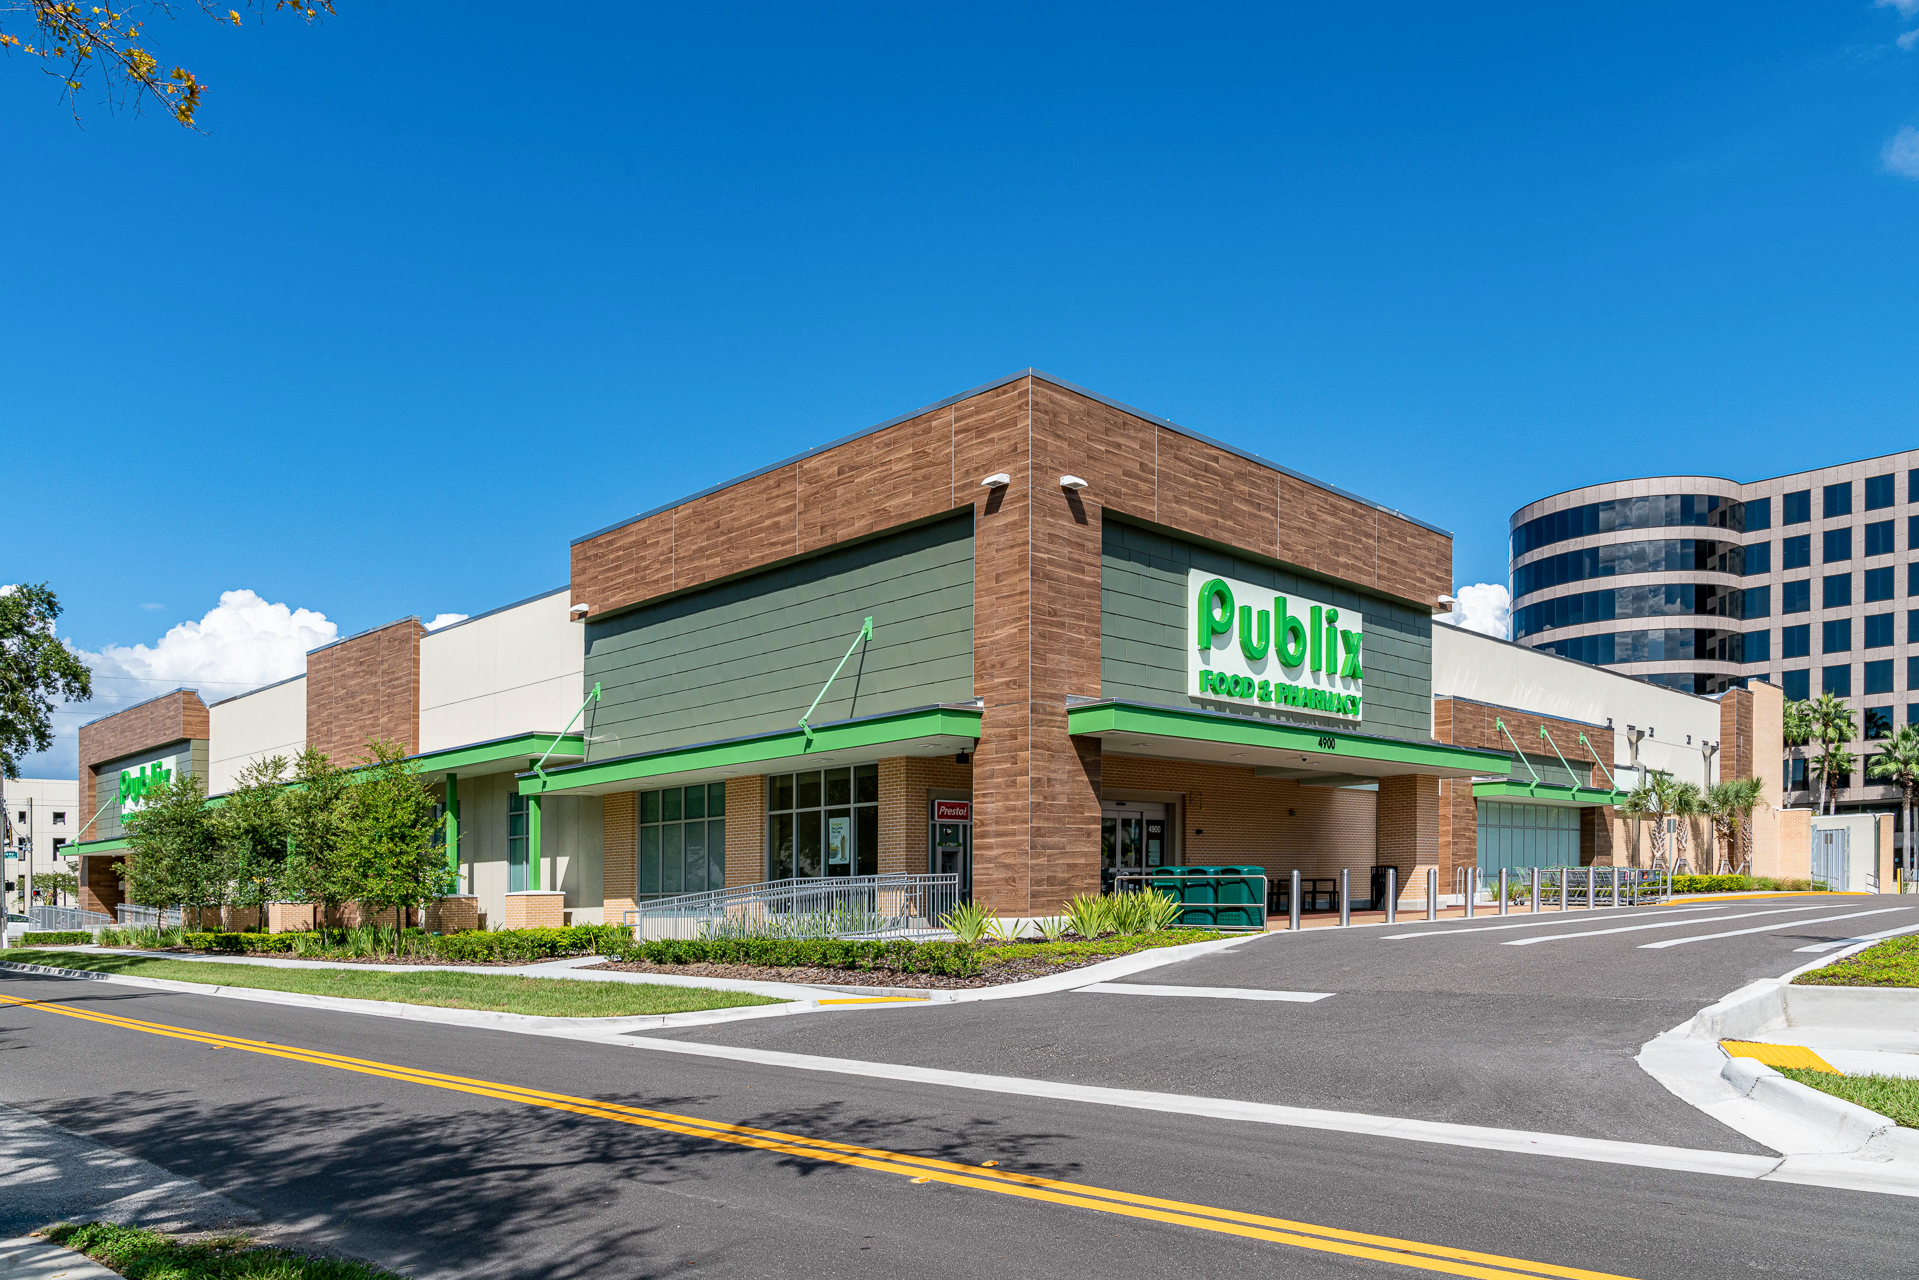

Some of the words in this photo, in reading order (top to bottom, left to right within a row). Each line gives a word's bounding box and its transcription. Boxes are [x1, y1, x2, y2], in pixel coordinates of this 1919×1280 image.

[1198, 578, 1363, 680] Publix
[1199, 669, 1255, 698] FOOD
[1257, 679, 1273, 702] &
[1274, 682, 1363, 716] PHARMACY
[1318, 736, 1336, 750] 4900
[938, 805, 968, 817] Presto!
[1148, 825, 1161, 833] 4900
